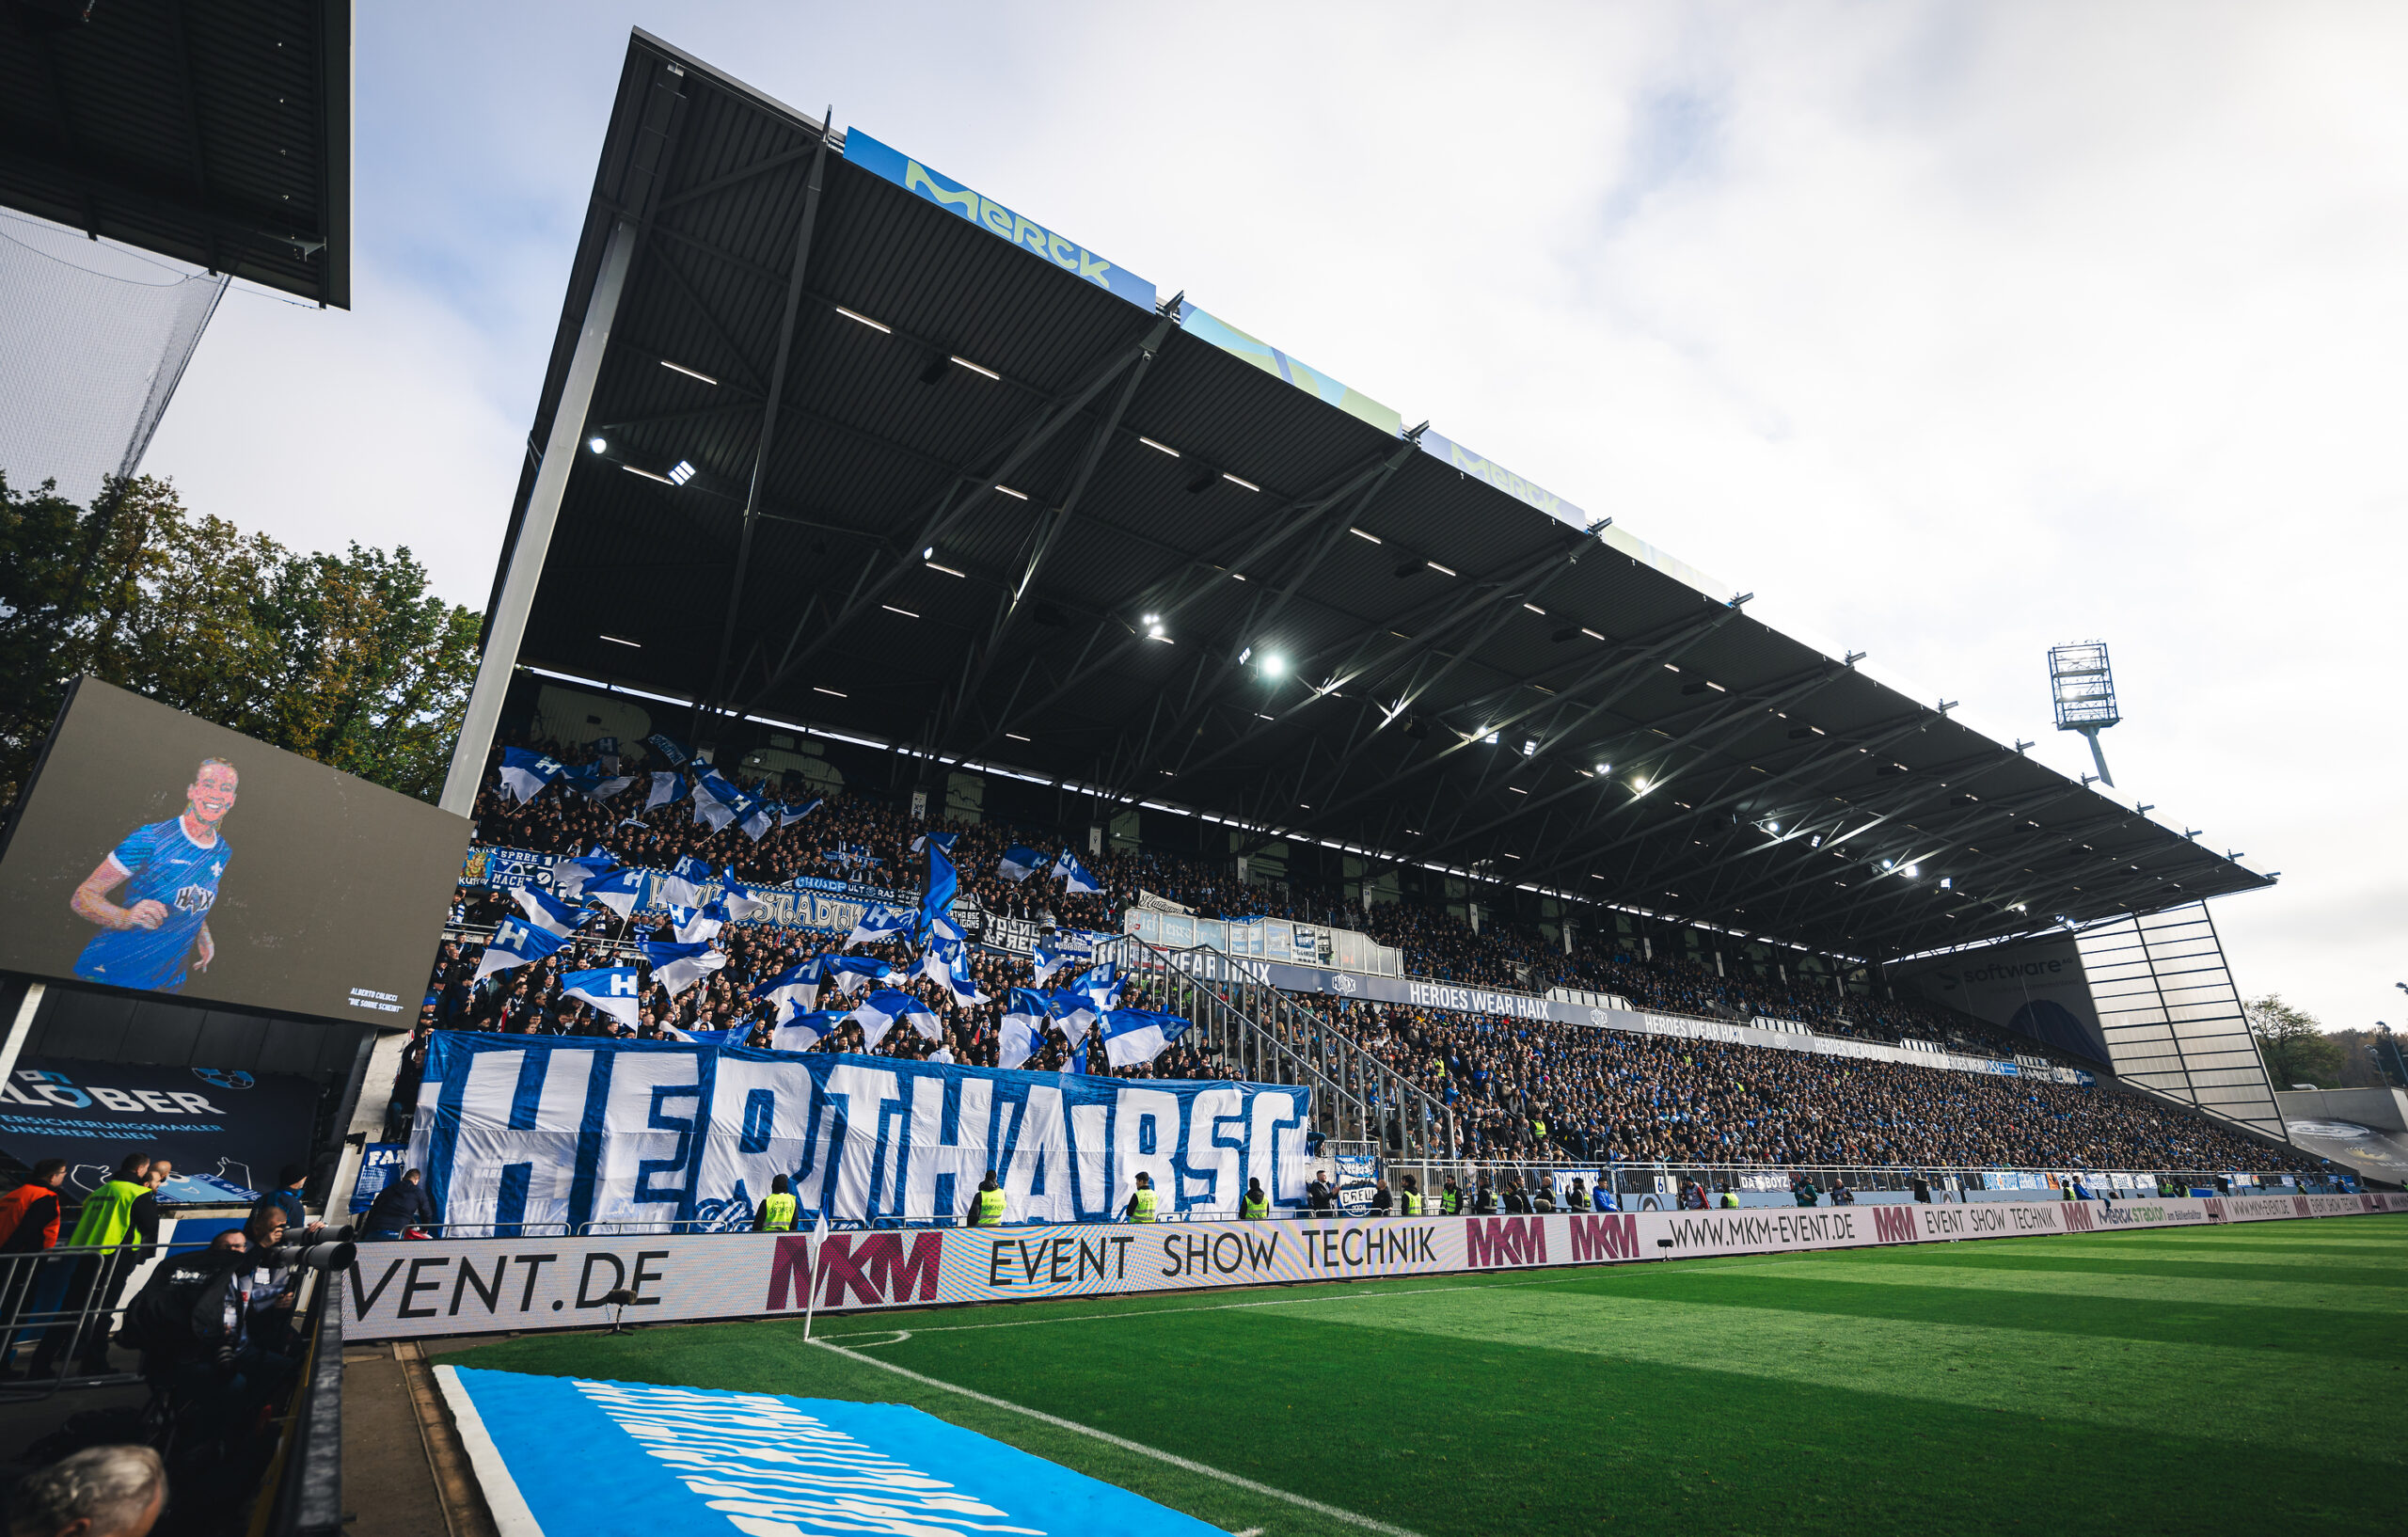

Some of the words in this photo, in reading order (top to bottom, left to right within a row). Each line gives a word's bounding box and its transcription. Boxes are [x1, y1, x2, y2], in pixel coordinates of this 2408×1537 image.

[500, 850, 539, 863] SPREE
[673, 854, 694, 876] H
[176, 887, 214, 912] HAIX
[668, 903, 687, 924] H
[866, 904, 892, 928] H
[985, 913, 1040, 939] YOUNG
[495, 920, 530, 951] H
[1091, 964, 1111, 982] H
[1225, 959, 1270, 987] HAIX
[1963, 959, 2062, 983] software
[350, 987, 376, 999] ALBERTO
[610, 973, 638, 996] H
[1409, 982, 1469, 1010] HEROES
[1471, 989, 1515, 1016] WEAR
[1516, 997, 1550, 1021] HAIX
[1643, 1014, 1687, 1038] HEROES
[1688, 1020, 1720, 1042] WEAR
[1720, 1024, 1745, 1044] HAIX
[1814, 1037, 1847, 1057] HEROES
[1846, 1042, 1872, 1060] WEAR
[1871, 1046, 1890, 1063] HAIX
[98, 1131, 159, 1140] LILIEN
[442, 1047, 1082, 1235] HERTHA
[1113, 1087, 1298, 1223] BSC
[1657, 1177, 1664, 1194] 6
[1741, 1176, 1756, 1189] DA
[1765, 1176, 1789, 1189] BOYZ
[1342, 1189, 1374, 1204] CREW
[1872, 1206, 1919, 1243] MKM
[1925, 1209, 1965, 1235] EVENT
[1971, 1208, 2006, 1232] SHOW
[2009, 1207, 2057, 1229] TECHNIK
[2060, 1202, 2094, 1231] MKM
[1465, 1216, 1548, 1268] MKM
[1569, 1213, 1640, 1261] MKM
[1669, 1212, 1856, 1249] WWW.MKM-EVENT.DE
[989, 1235, 1134, 1287] EVENT
[1162, 1230, 1279, 1278] SHOW
[1302, 1226, 1437, 1270] TECHNIK
[765, 1231, 944, 1311] MKM
